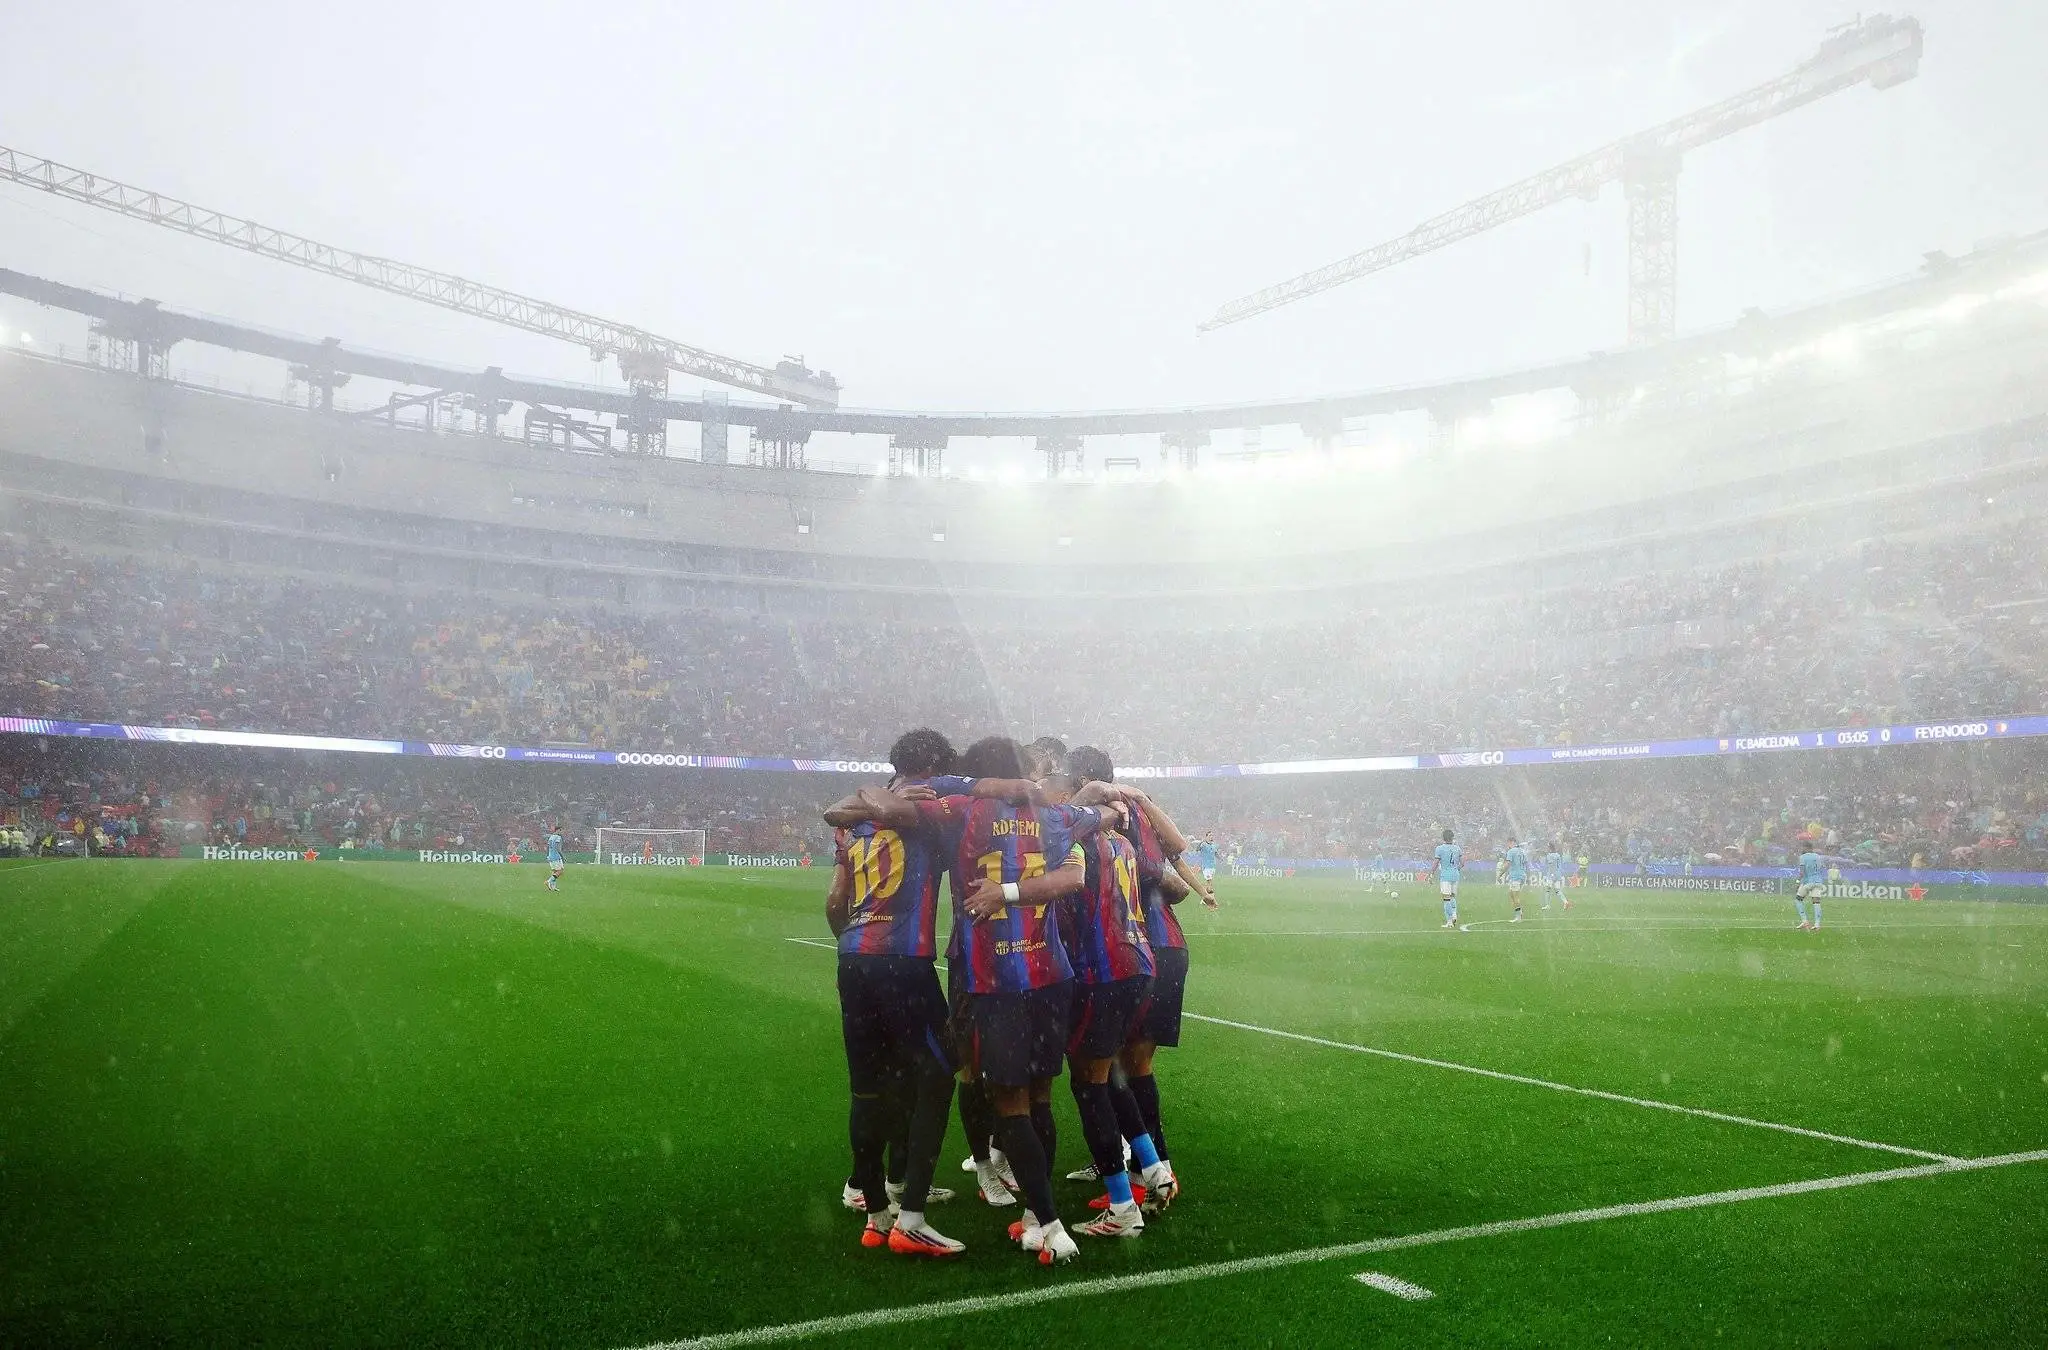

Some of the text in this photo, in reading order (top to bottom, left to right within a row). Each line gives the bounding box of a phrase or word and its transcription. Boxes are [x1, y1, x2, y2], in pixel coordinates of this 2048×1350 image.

[1747, 735, 1800, 749] BARCELONA
[1838, 731, 1868, 744] 03:05
[1915, 723, 1988, 739] FEYENOORD
[480, 745, 506, 758] GO
[540, 751, 573, 759] CHAMPIONS
[574, 752, 596, 760] LEAGUE
[1481, 750, 1504, 765] GO
[1552, 745, 1650, 759] UEFA CHAMPIONS LEAGUE
[203, 845, 298, 862] Heineken
[419, 849, 504, 864] Heineken
[610, 852, 686, 866] Heineken
[727, 854, 798, 867] Heineken
[848, 830, 904, 907] 10
[1231, 863, 1283, 877] Heineken
[1617, 876, 1756, 892] UEFA CHAMPIONS LEAGUE
[1819, 880, 1903, 900] eineken
